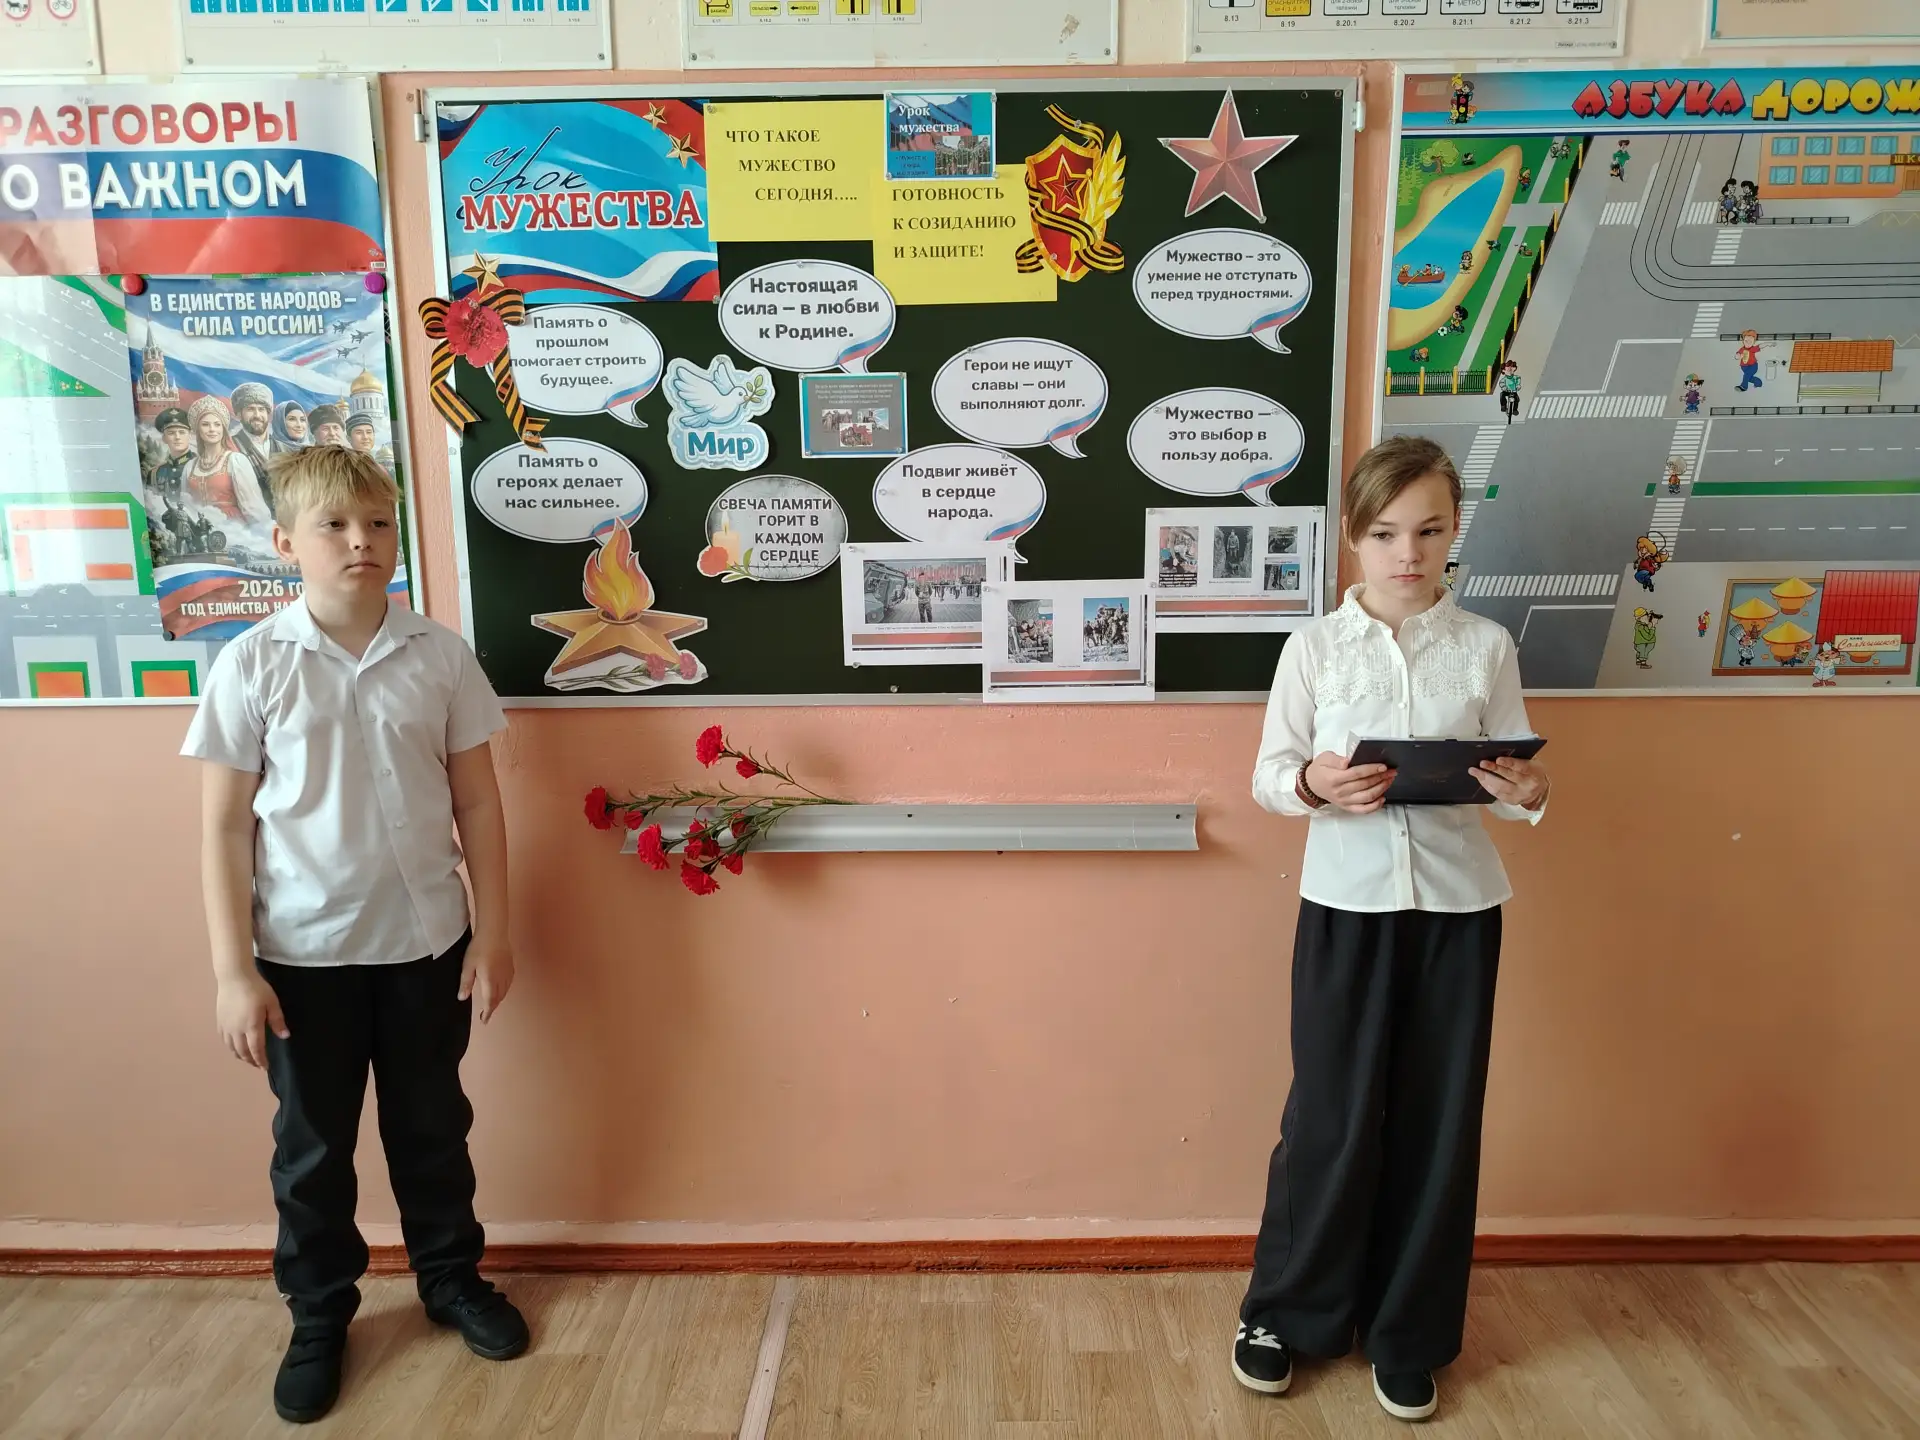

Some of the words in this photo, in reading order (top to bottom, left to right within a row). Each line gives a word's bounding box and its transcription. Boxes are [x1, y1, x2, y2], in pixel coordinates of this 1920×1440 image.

[1572, 76, 1746, 119] АЗБУКА
[1751, 77, 1920, 121] ДОРОЖ
[898, 105, 931, 119] Урок
[0, 101, 297, 146] РАЗГОВОРЫ
[899, 124, 960, 136] мужества
[726, 130, 760, 143] ЧТО
[764, 130, 820, 142] ТАКОЕ
[738, 159, 836, 172] МУЖЕСТВО
[1894, 154, 1920, 164] ШК
[456, 126, 586, 220] Урок
[1, 164, 39, 212] О
[59, 159, 307, 210] ВАЖНОМ
[892, 187, 1004, 201] ГОТОВНОСТЬ
[461, 190, 704, 232] МУЖЕСТВА
[893, 217, 903, 230] К
[908, 216, 1016, 231] СОЗИДАНИЮ
[893, 246, 905, 258] И
[910, 245, 984, 258] ЗАЩИТЕ!
[1166, 250, 1242, 264] Мужество
[1257, 252, 1281, 261] это
[1147, 271, 1201, 283] умение
[1204, 272, 1222, 280] не
[1225, 271, 1298, 283] отступать
[750, 278, 858, 294] Настоящая
[1151, 290, 1193, 301] перед
[1196, 289, 1293, 301] трудностями.
[150, 293, 162, 312] В
[168, 293, 256, 314] ЕДИНСТВЕ
[261, 291, 341, 312] НАРОДОВ
[732, 303, 778, 315] сила
[801, 304, 811, 315] в
[816, 298, 880, 314] любви
[183, 316, 234, 336] СИЛА
[241, 315, 324, 336] РОССИИ!
[533, 316, 594, 329] Память
[598, 318, 607, 328] о
[759, 327, 770, 339] к
[775, 324, 854, 340] Родине.
[536, 337, 609, 350] прошлом
[510, 357, 581, 367] помогает
[585, 355, 647, 368] строить
[964, 359, 1008, 373] Герои
[1012, 361, 1030, 370] не
[1034, 360, 1073, 371] ищут
[540, 374, 613, 388] будущее.
[972, 381, 1018, 391] славы
[1038, 380, 1066, 389] они
[960, 400, 1045, 410] выполняют
[1048, 399, 1086, 409] долг.
[1165, 406, 1253, 423] Мужество
[1168, 431, 1196, 440] это
[1201, 427, 1253, 443] выбор
[1258, 431, 1267, 440] в
[688, 431, 755, 460] Мир
[518, 454, 584, 468] Память
[588, 457, 598, 468] о
[1161, 451, 1217, 463] пользу
[1220, 448, 1272, 462] добра.
[902, 465, 961, 479] Подвиг
[966, 464, 1018, 476] живёт
[497, 477, 558, 490] героях
[563, 477, 623, 490] делает
[922, 489, 931, 497] в
[936, 488, 996, 500] сердце
[505, 499, 537, 508] нас
[541, 498, 620, 509] сильнее.
[719, 499, 767, 510] СВЕЧА
[771, 498, 832, 510] ПАМЯТИ
[758, 515, 805, 526] ГОРИТ
[810, 515, 819, 526] В
[928, 508, 993, 520] народа.
[755, 533, 824, 545] КАЖДОМ
[760, 550, 819, 563] СЕРДЦЕ
[238, 579, 284, 598] 2026
[288, 582, 304, 596] ГО
[181, 603, 206, 617] ГОД
[208, 602, 271, 616] ЕДИНСТВА
